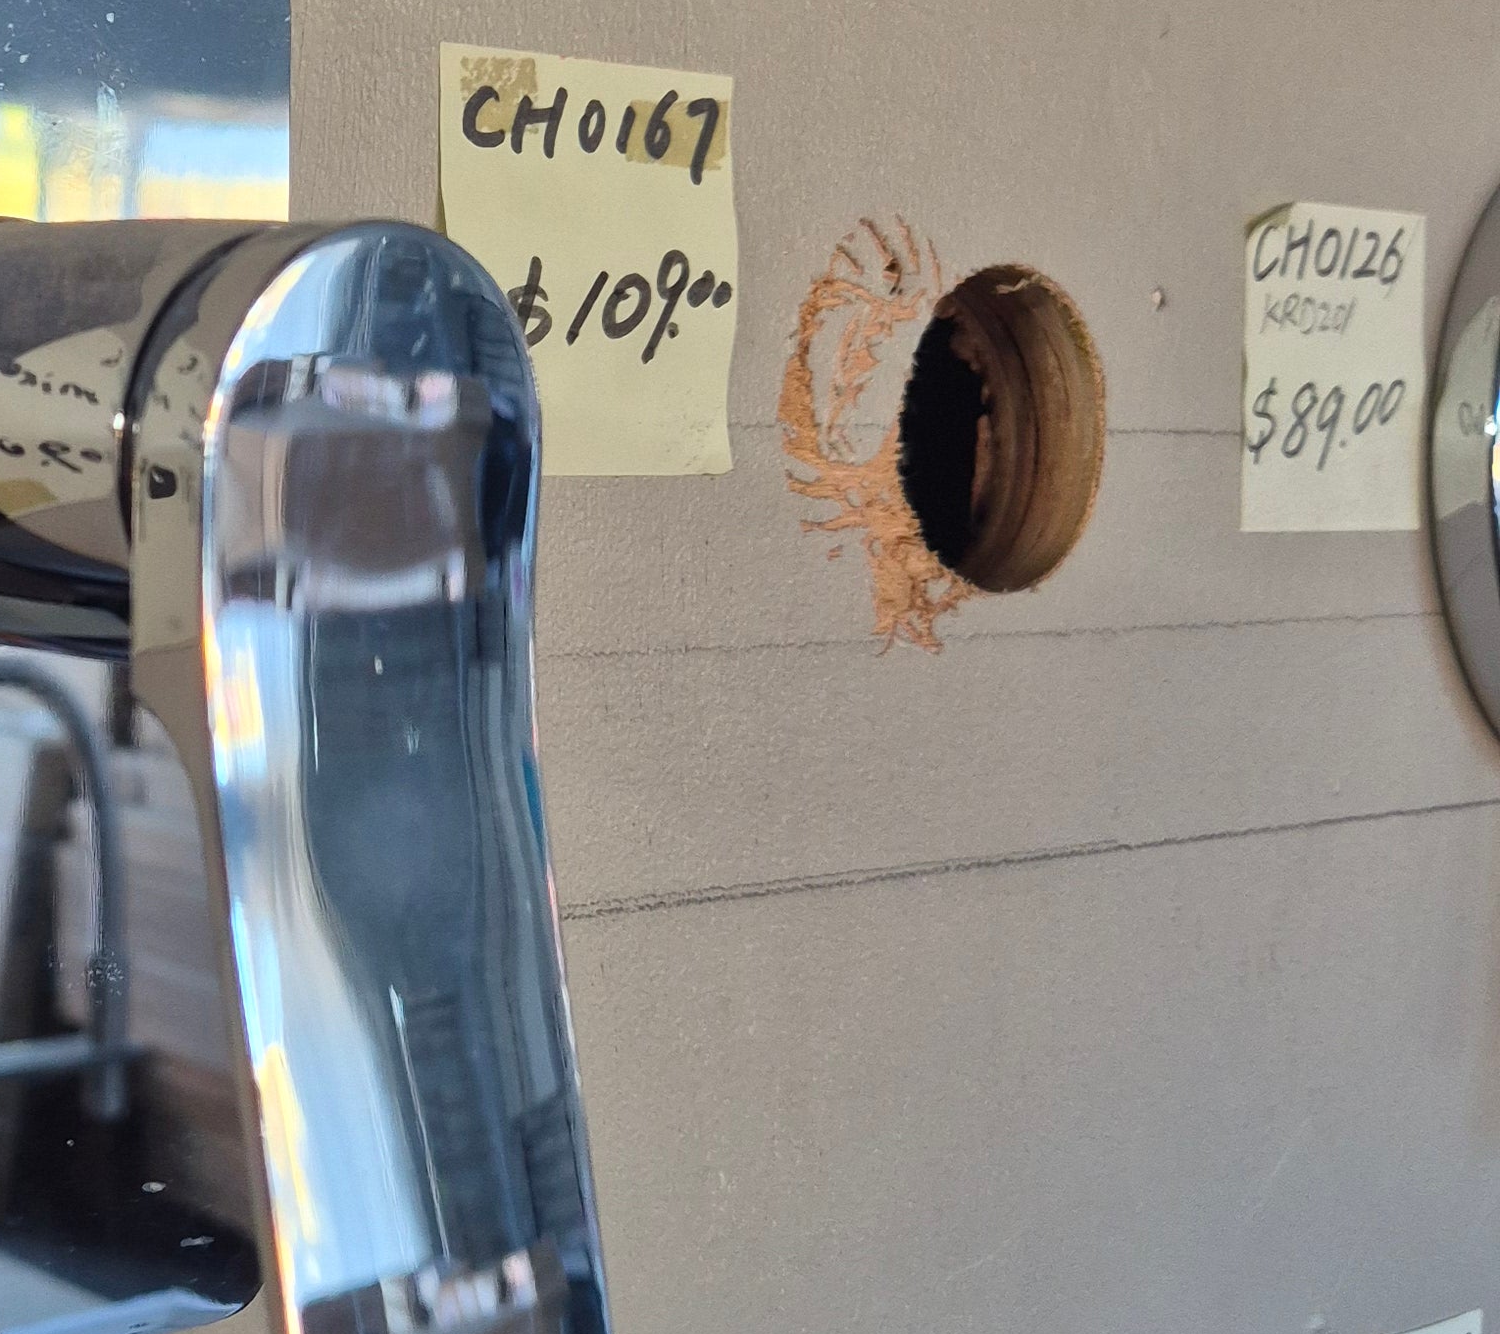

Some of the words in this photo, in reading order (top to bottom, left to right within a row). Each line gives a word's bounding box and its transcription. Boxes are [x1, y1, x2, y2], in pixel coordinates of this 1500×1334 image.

[461, 85, 720, 186] CH0167
[1253, 219, 1406, 287] CH0126
[507, 249, 733, 365] $109.00
[1248, 377, 1406, 471] $89.00
